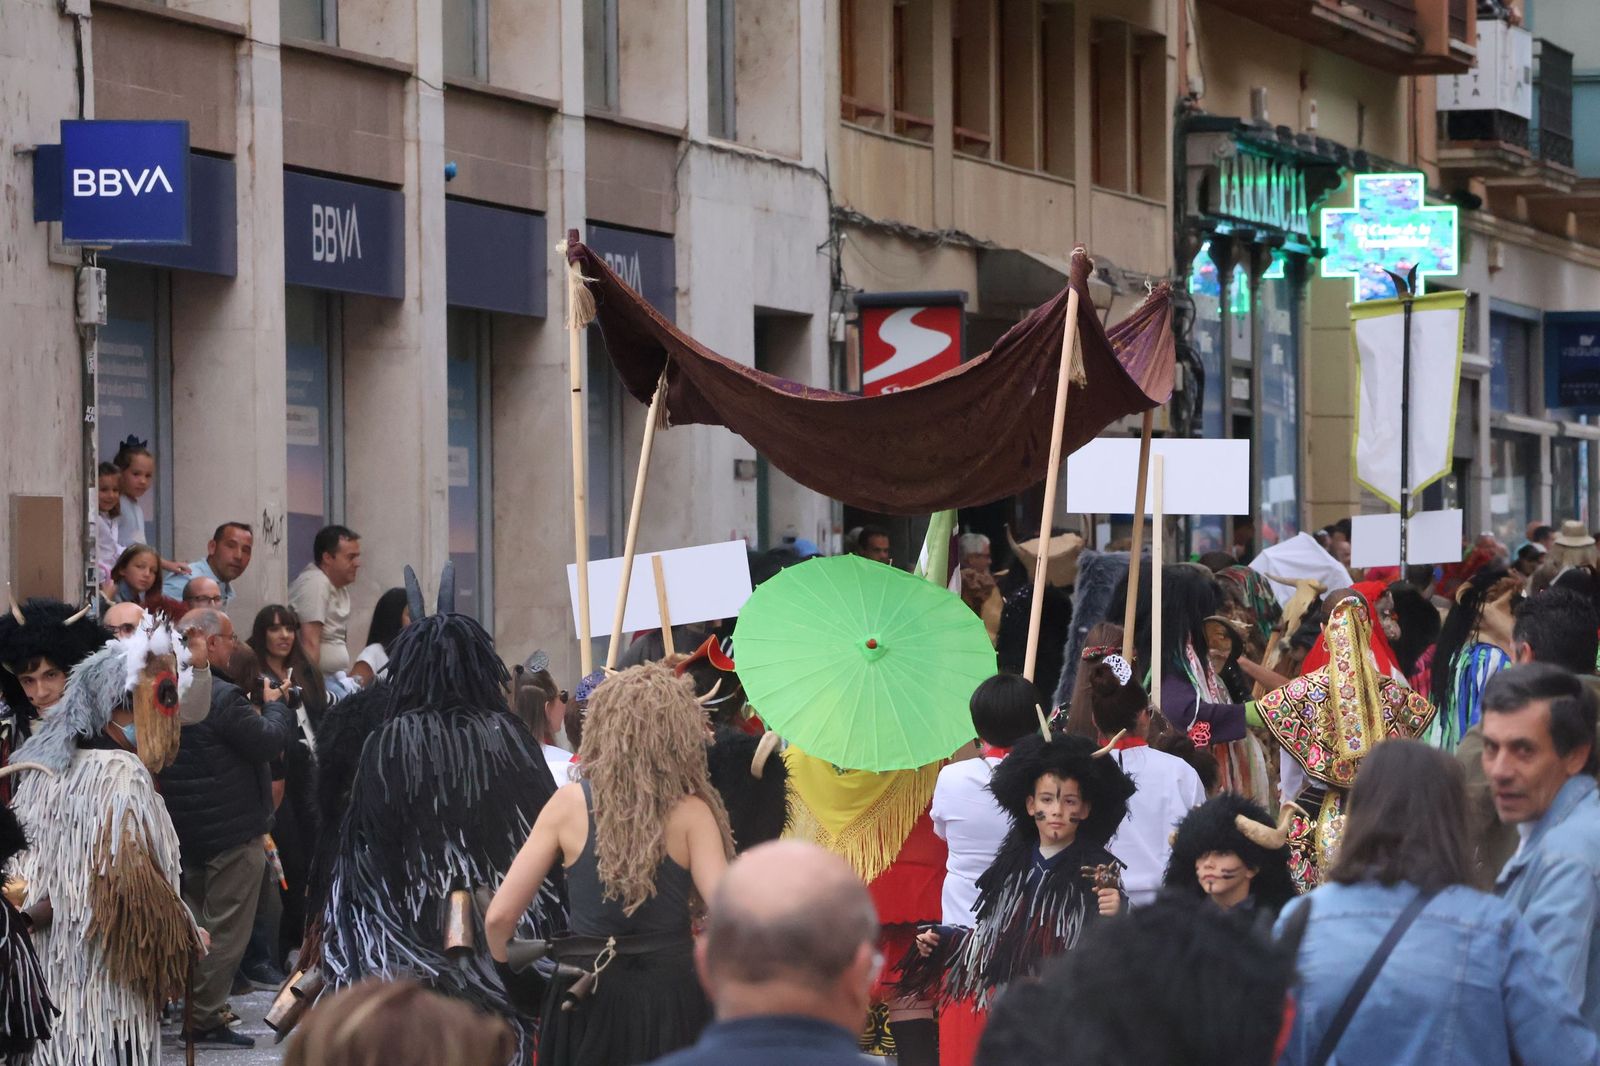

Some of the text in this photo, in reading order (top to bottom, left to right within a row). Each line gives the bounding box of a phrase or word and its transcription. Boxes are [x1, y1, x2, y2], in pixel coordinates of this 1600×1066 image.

[73, 165, 174, 197] BBVA
[1219, 156, 1308, 235] FARMACIA
[312, 203, 362, 263] BBVA
